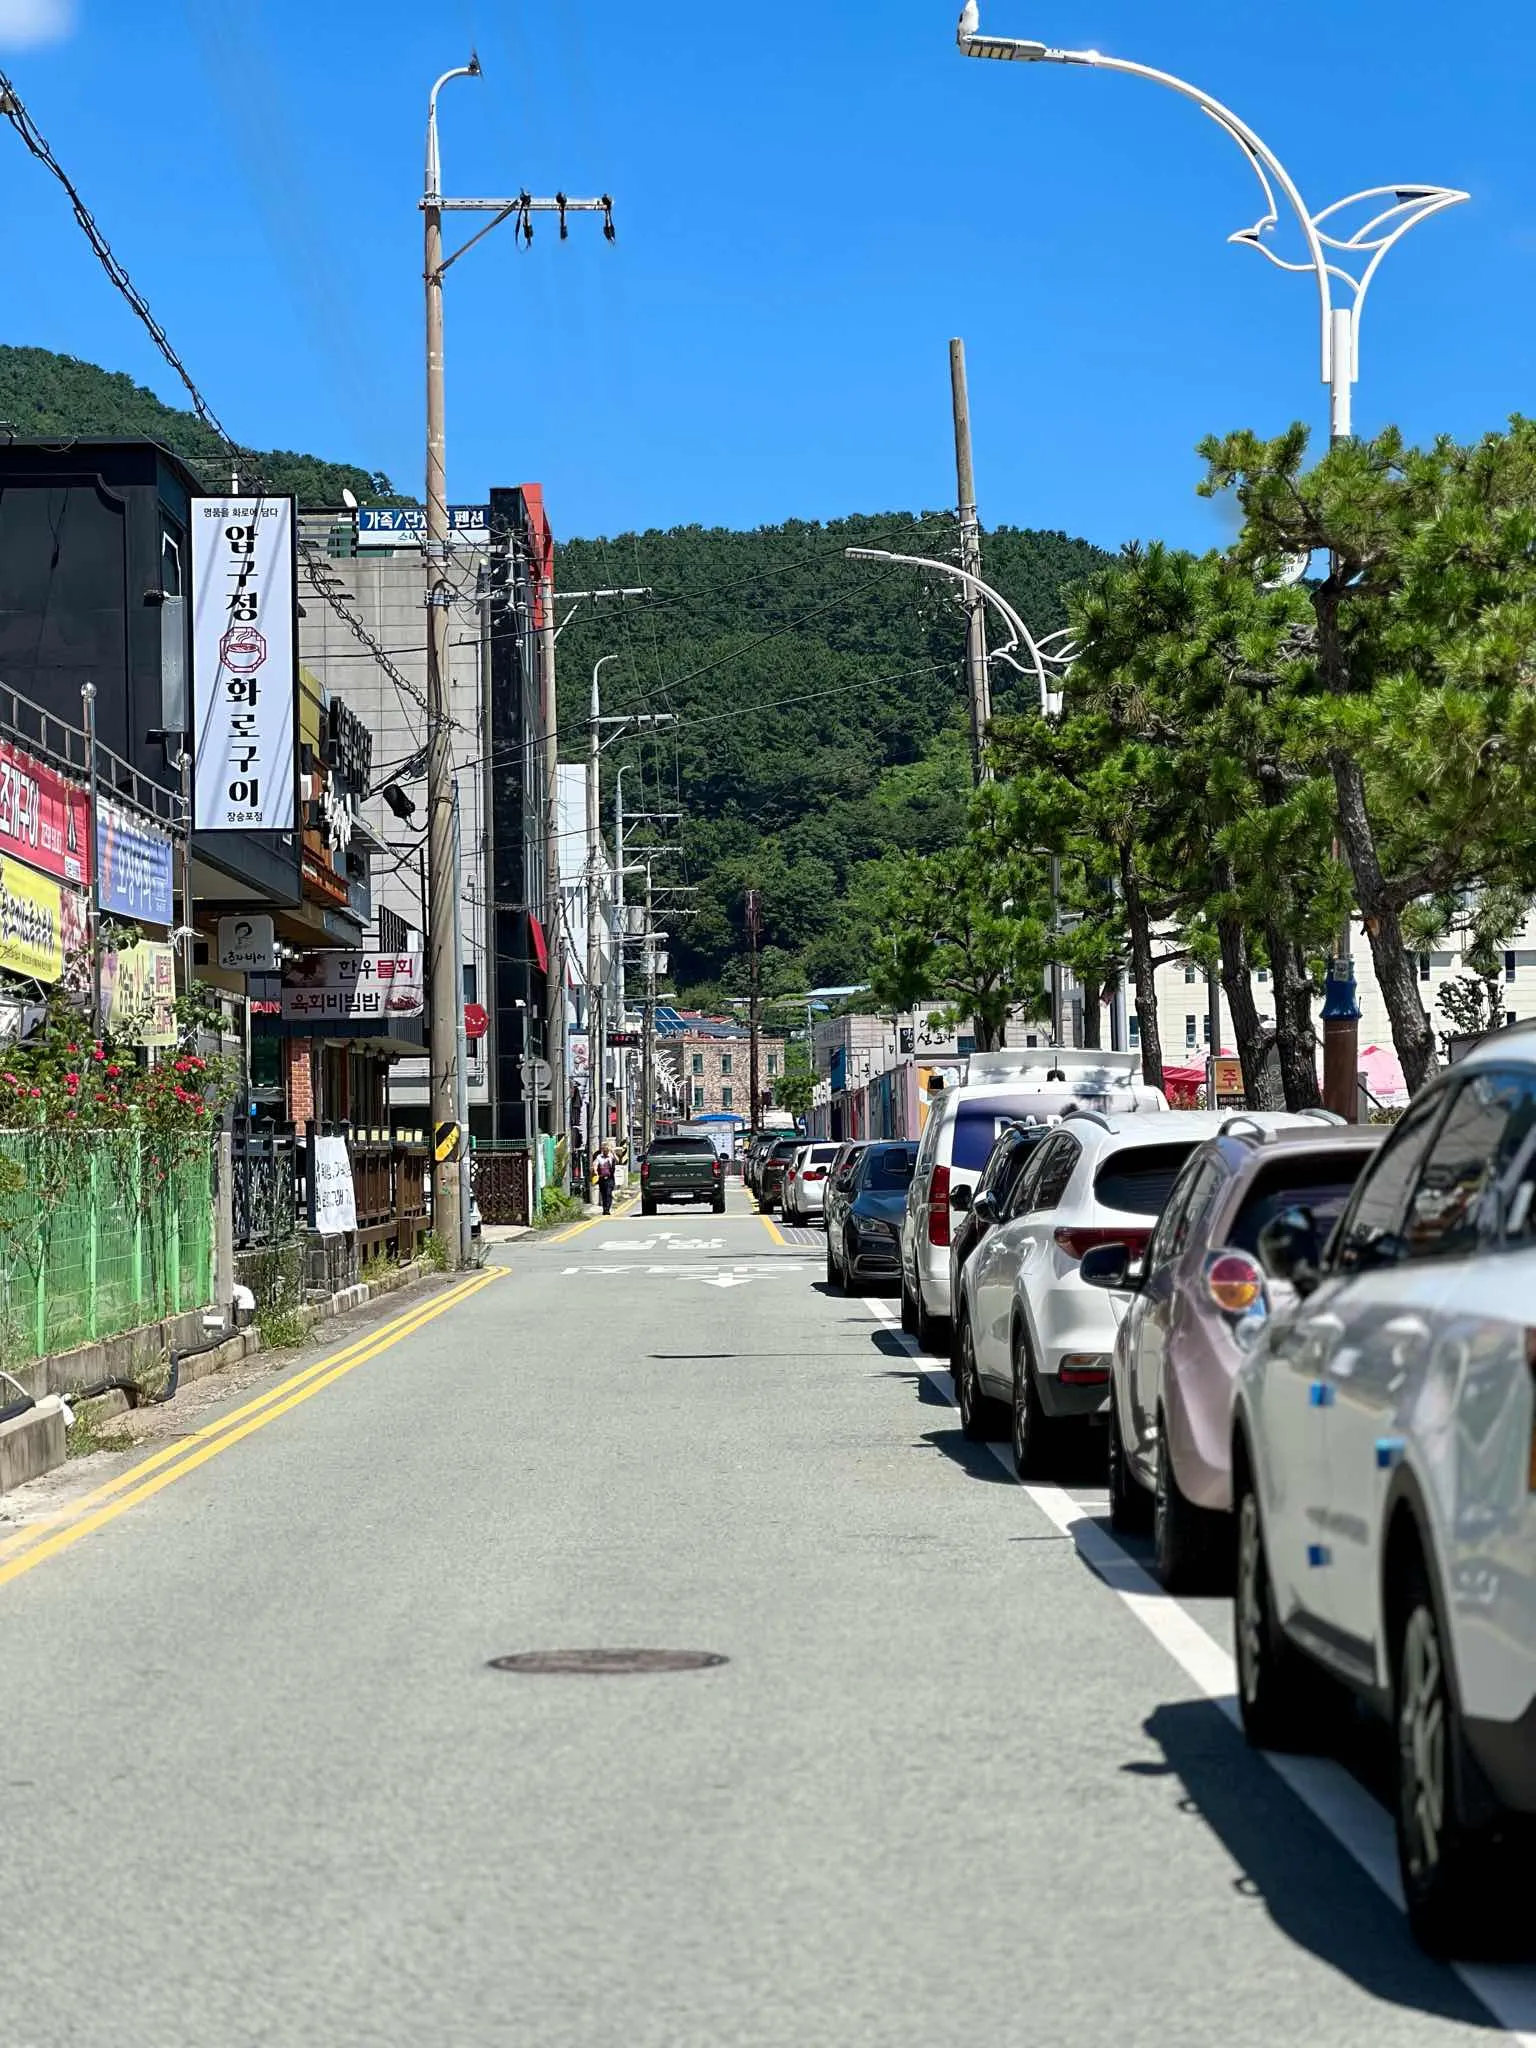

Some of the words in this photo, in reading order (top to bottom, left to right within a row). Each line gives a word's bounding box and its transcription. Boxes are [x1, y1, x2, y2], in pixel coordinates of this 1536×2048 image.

[232, 508, 258, 517] 화로에
[261, 508, 279, 517] 담다
[454, 510, 485, 529] 펜션
[227, 811, 264, 823] 장승포점
[290, 992, 381, 1014] 육회비빔밥
